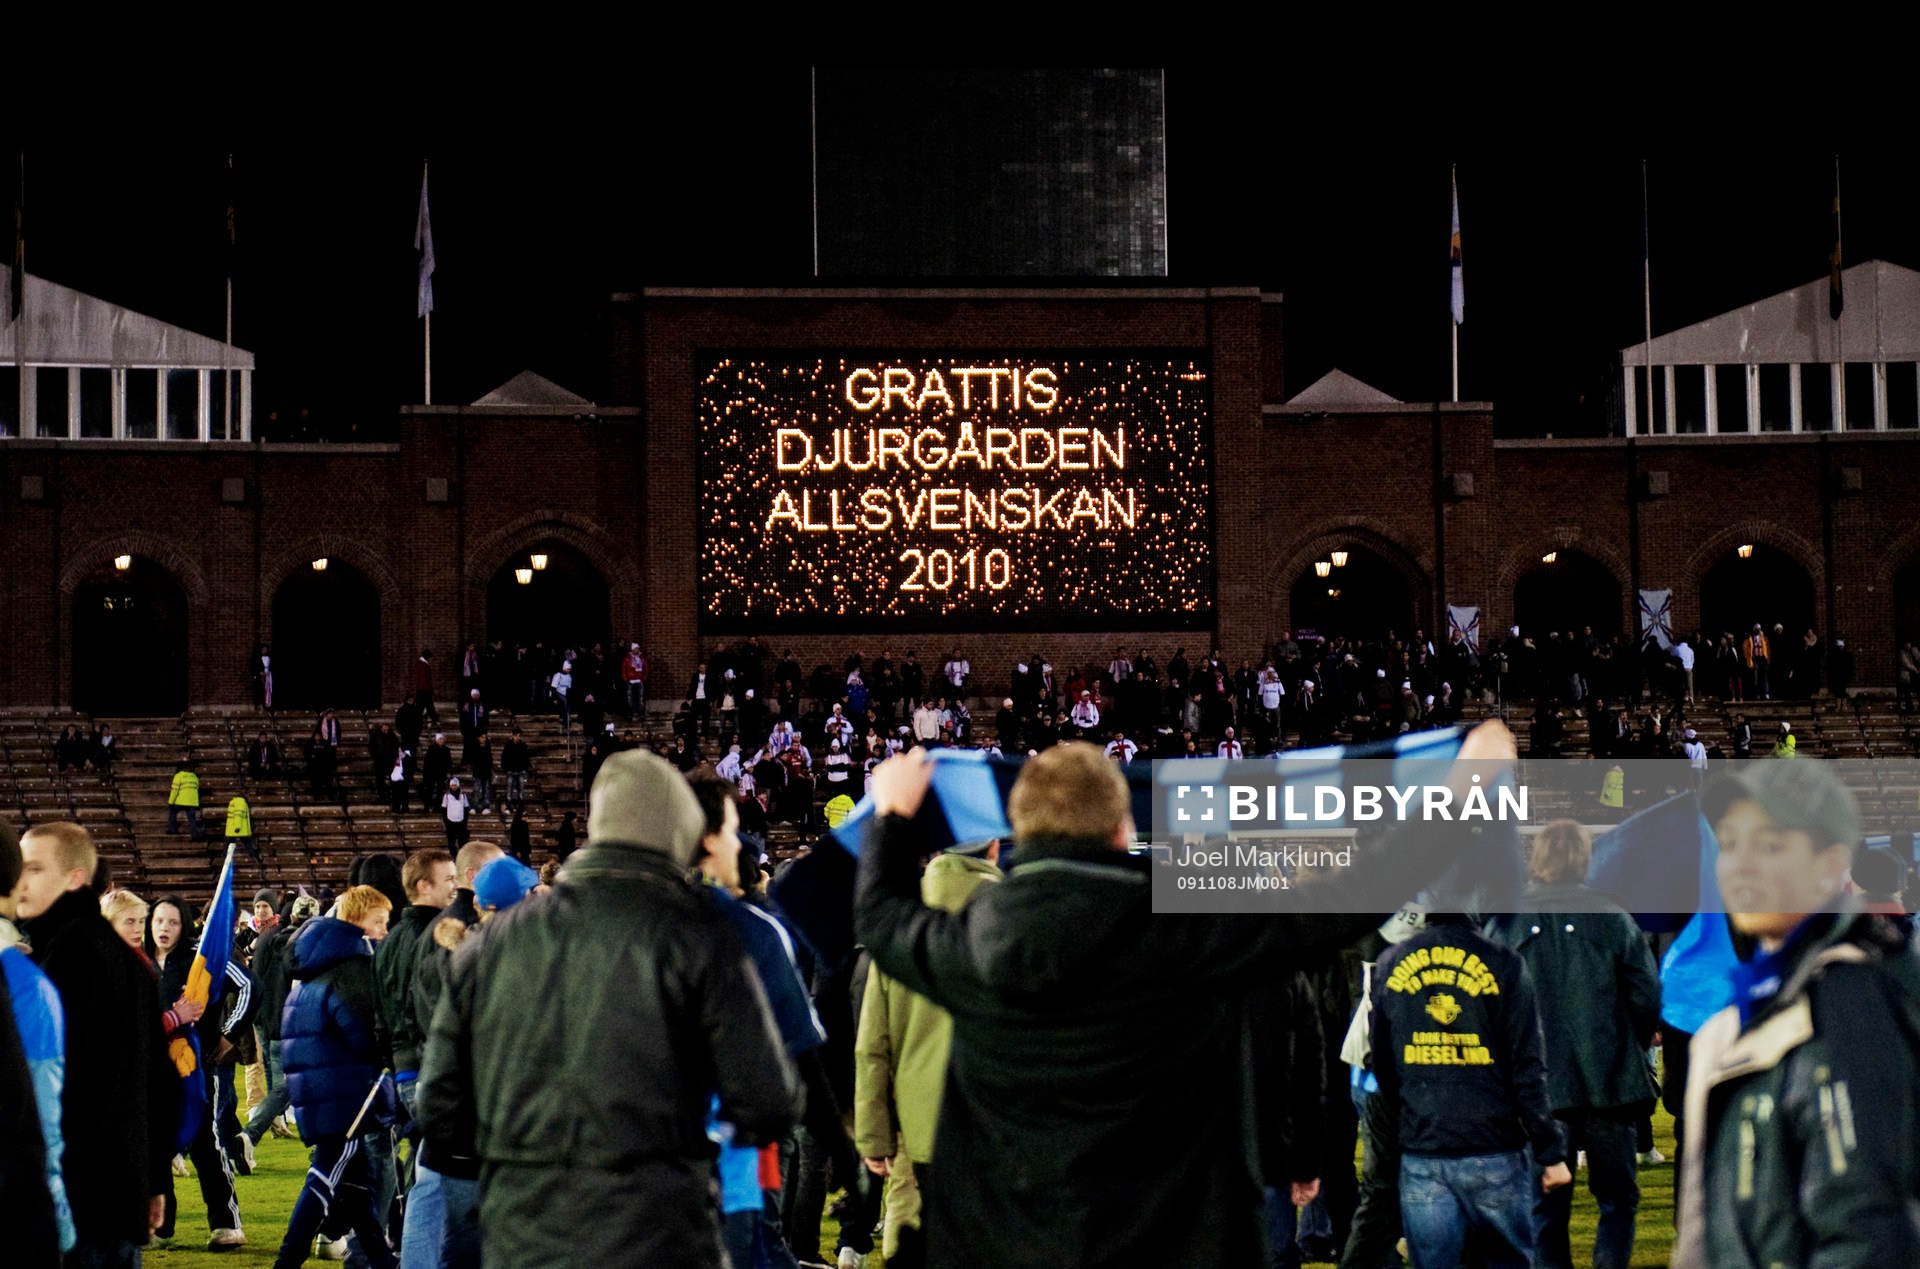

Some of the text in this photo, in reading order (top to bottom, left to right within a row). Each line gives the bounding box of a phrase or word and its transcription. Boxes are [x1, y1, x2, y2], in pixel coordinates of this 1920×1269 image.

[845, 368, 1058, 410] GRATTIS
[776, 421, 1125, 471] DJURGÅRDEN
[765, 488, 1137, 531] ALLSVENSKAN
[899, 548, 1011, 591] 2010
[1386, 946, 1500, 995] DOING OUR BEST
[1404, 975, 1422, 995] TO
[1420, 969, 1457, 985] MAKE
[1412, 1031, 1480, 1046] LOOK BETTER
